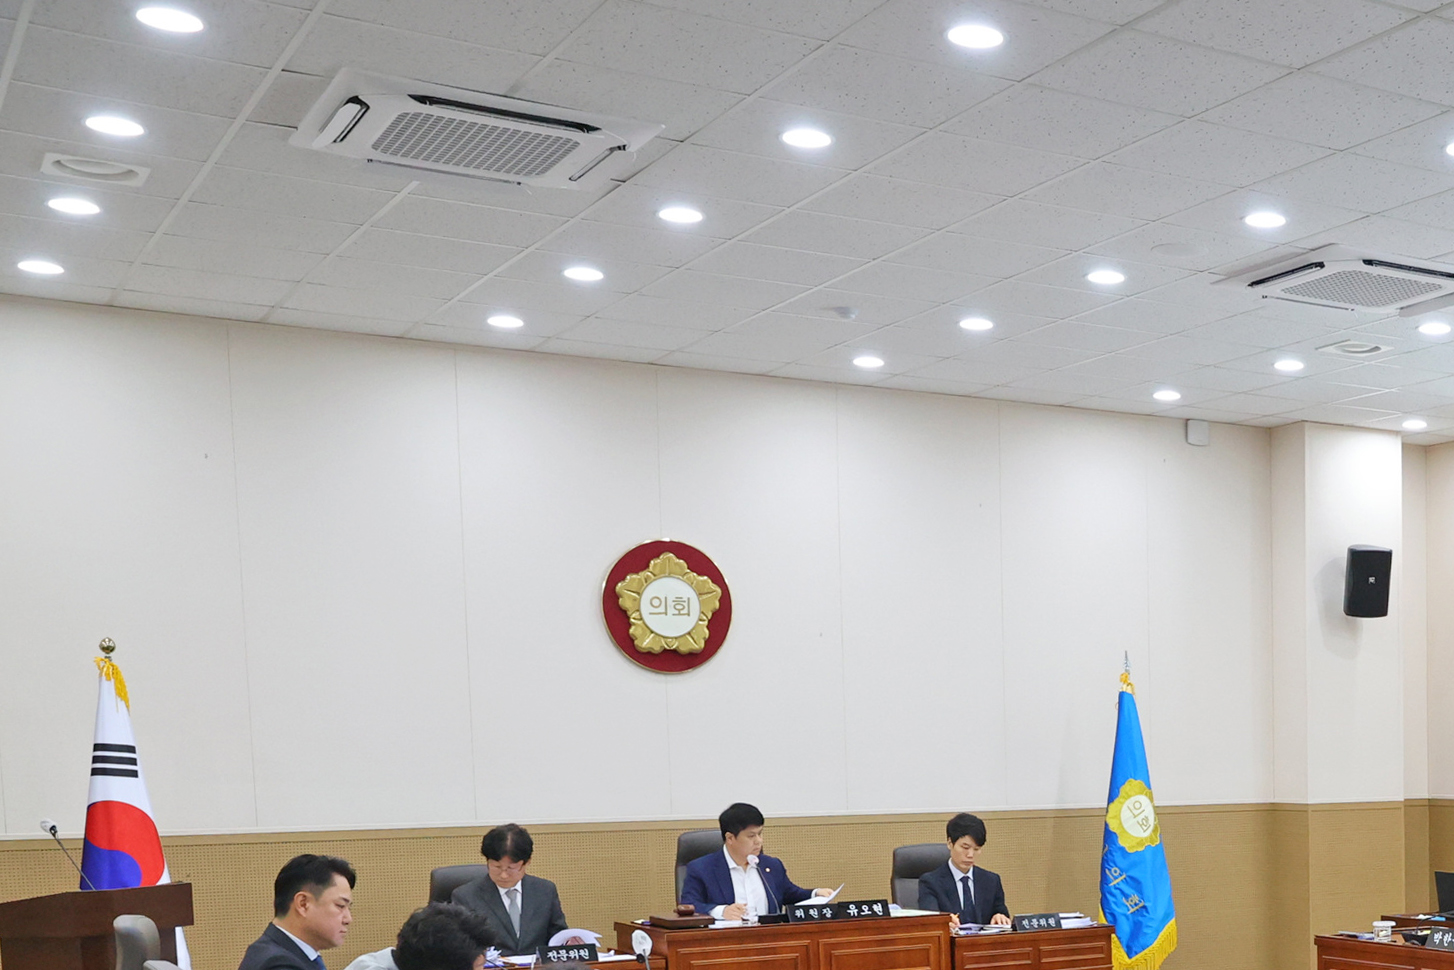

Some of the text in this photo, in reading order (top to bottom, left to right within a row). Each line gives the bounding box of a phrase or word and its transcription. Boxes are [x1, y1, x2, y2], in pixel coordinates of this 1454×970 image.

[648, 596, 690, 617] 의회
[1126, 800, 1152, 833] 의회
[794, 902, 883, 918] 위원장 유오현
[1022, 917, 1056, 929] 전문위원
[546, 948, 590, 962] 전문위원
